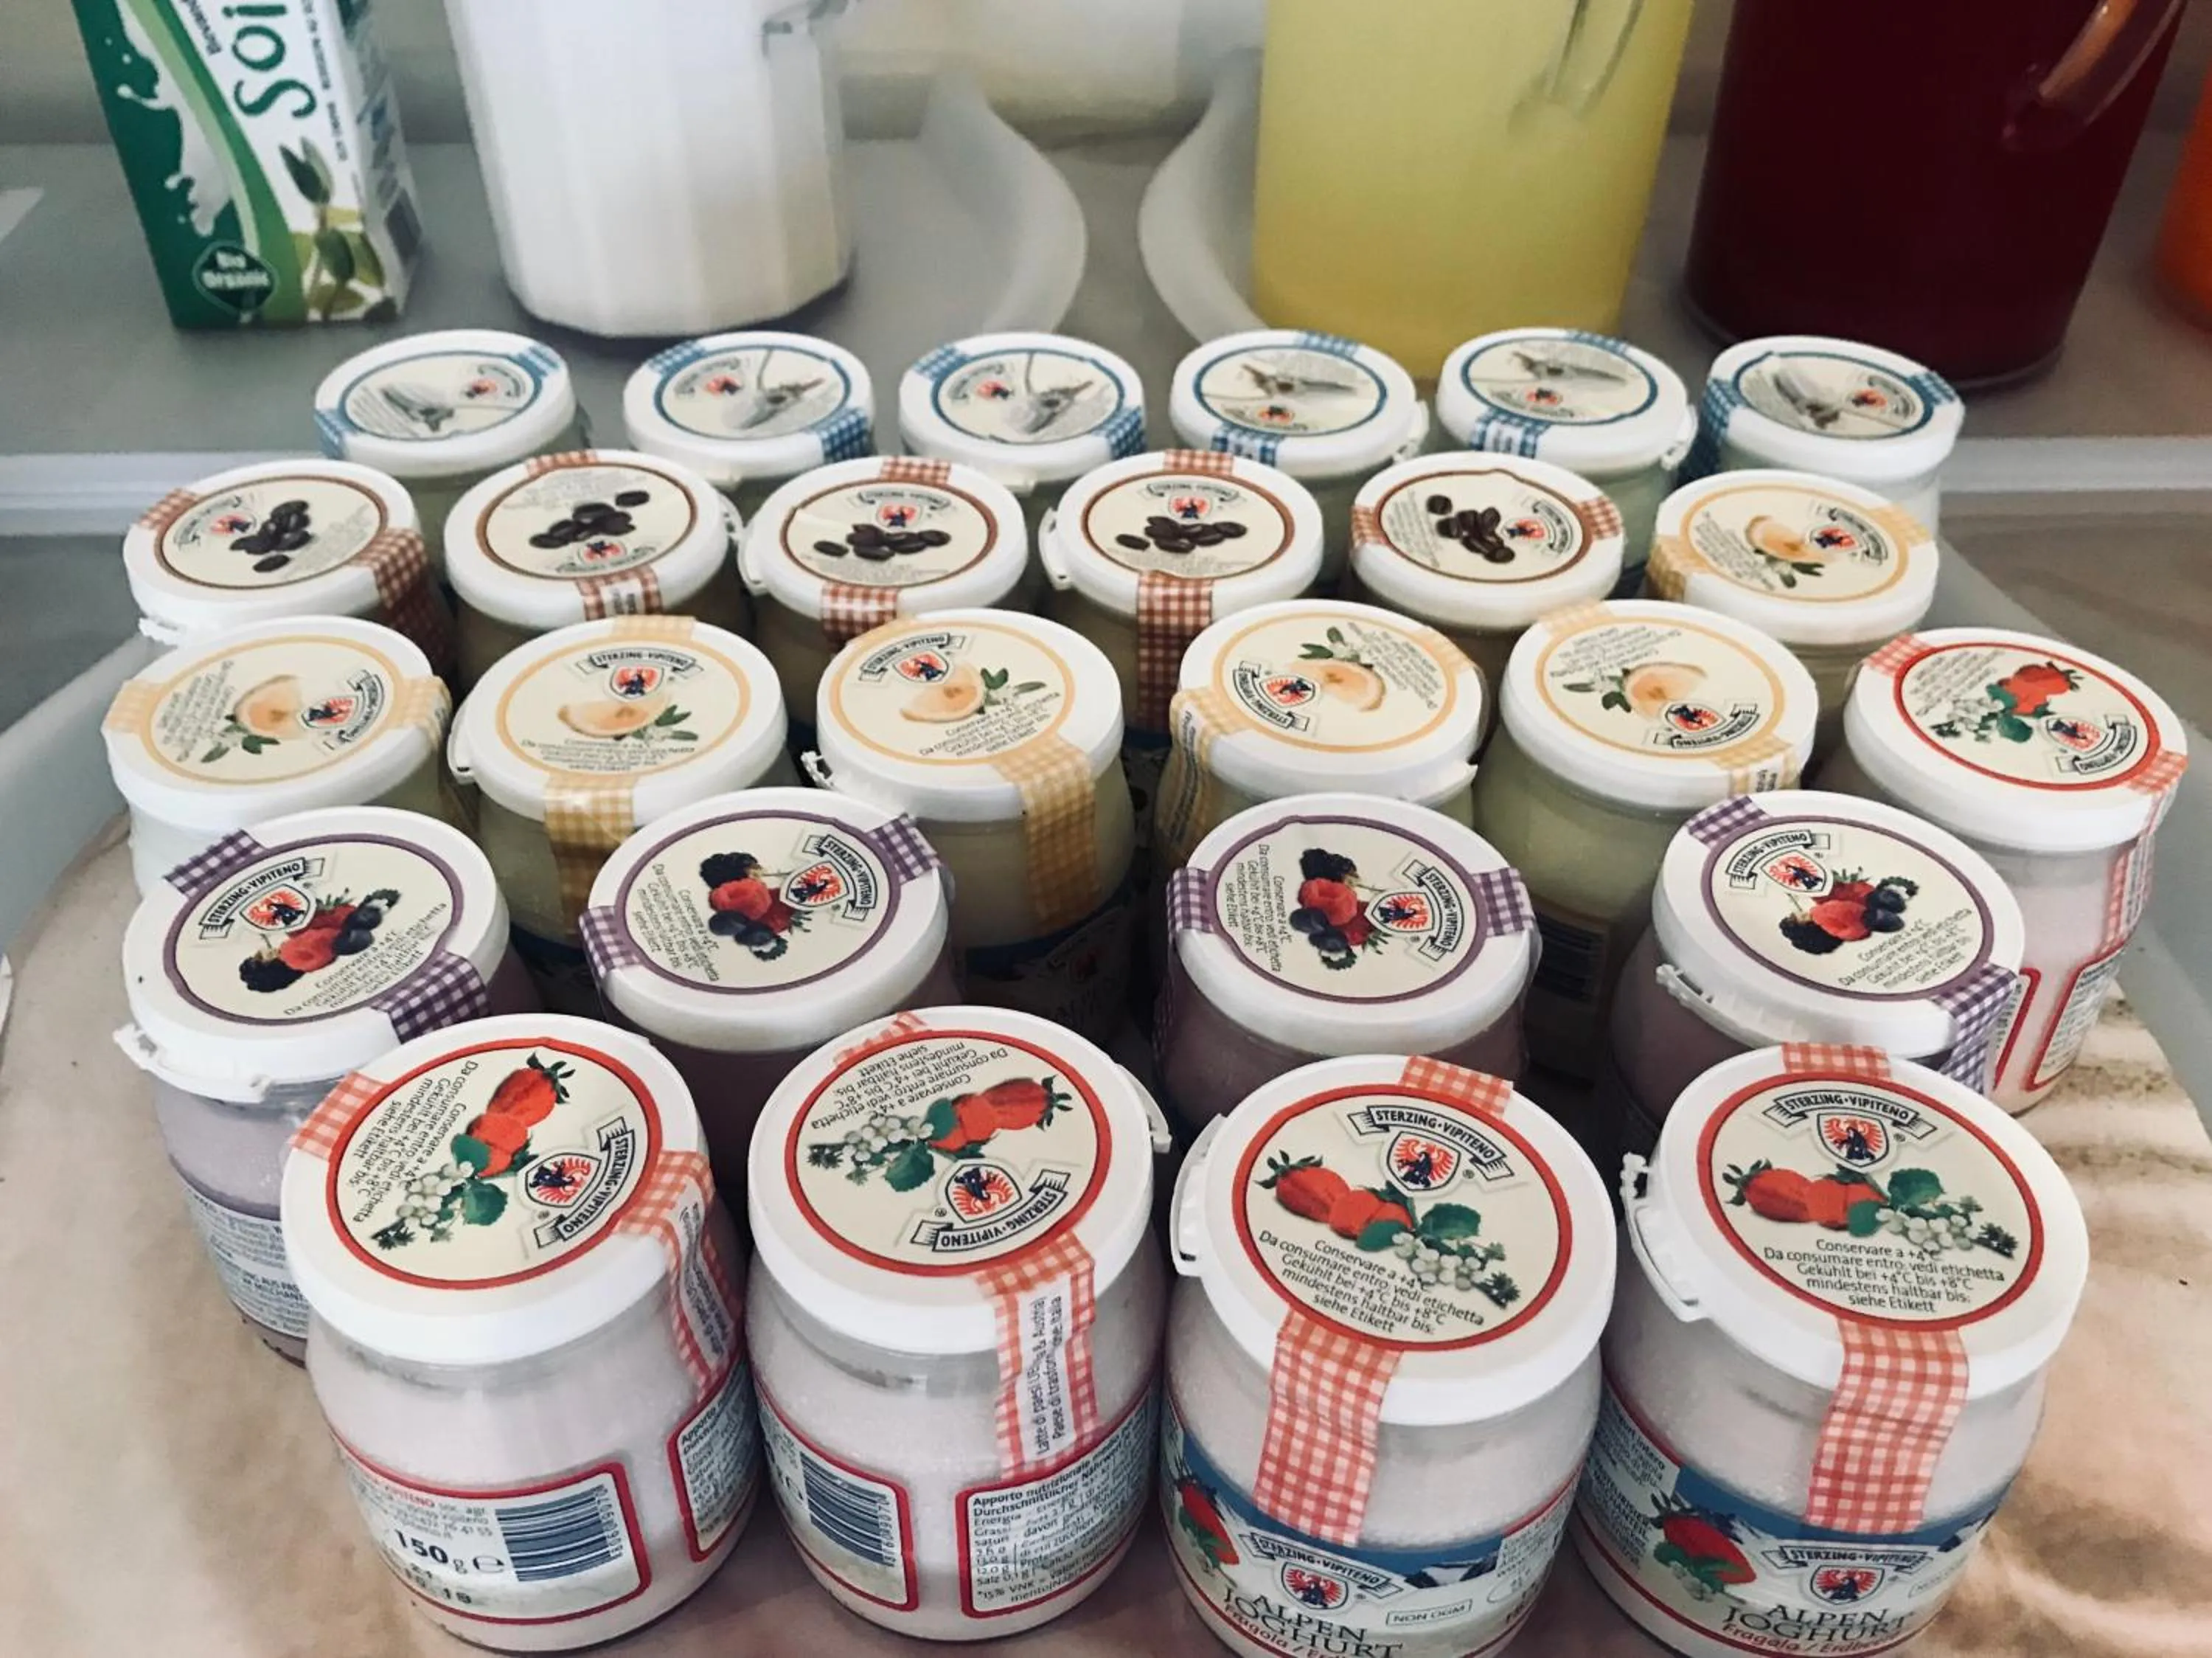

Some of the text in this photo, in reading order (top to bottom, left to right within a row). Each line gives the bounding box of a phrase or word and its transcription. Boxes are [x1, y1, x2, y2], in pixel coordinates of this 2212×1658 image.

[1259, 1229, 1279, 1246] Da
[1764, 1247, 1784, 1260] Da
[974, 1491, 1023, 1508] Apporto
[394, 1528, 448, 1564] 150
[1253, 1595, 1368, 1643] ALPEN
[1767, 1603, 1889, 1627] ALPEN
[1722, 1623, 1799, 1651] Fragola
